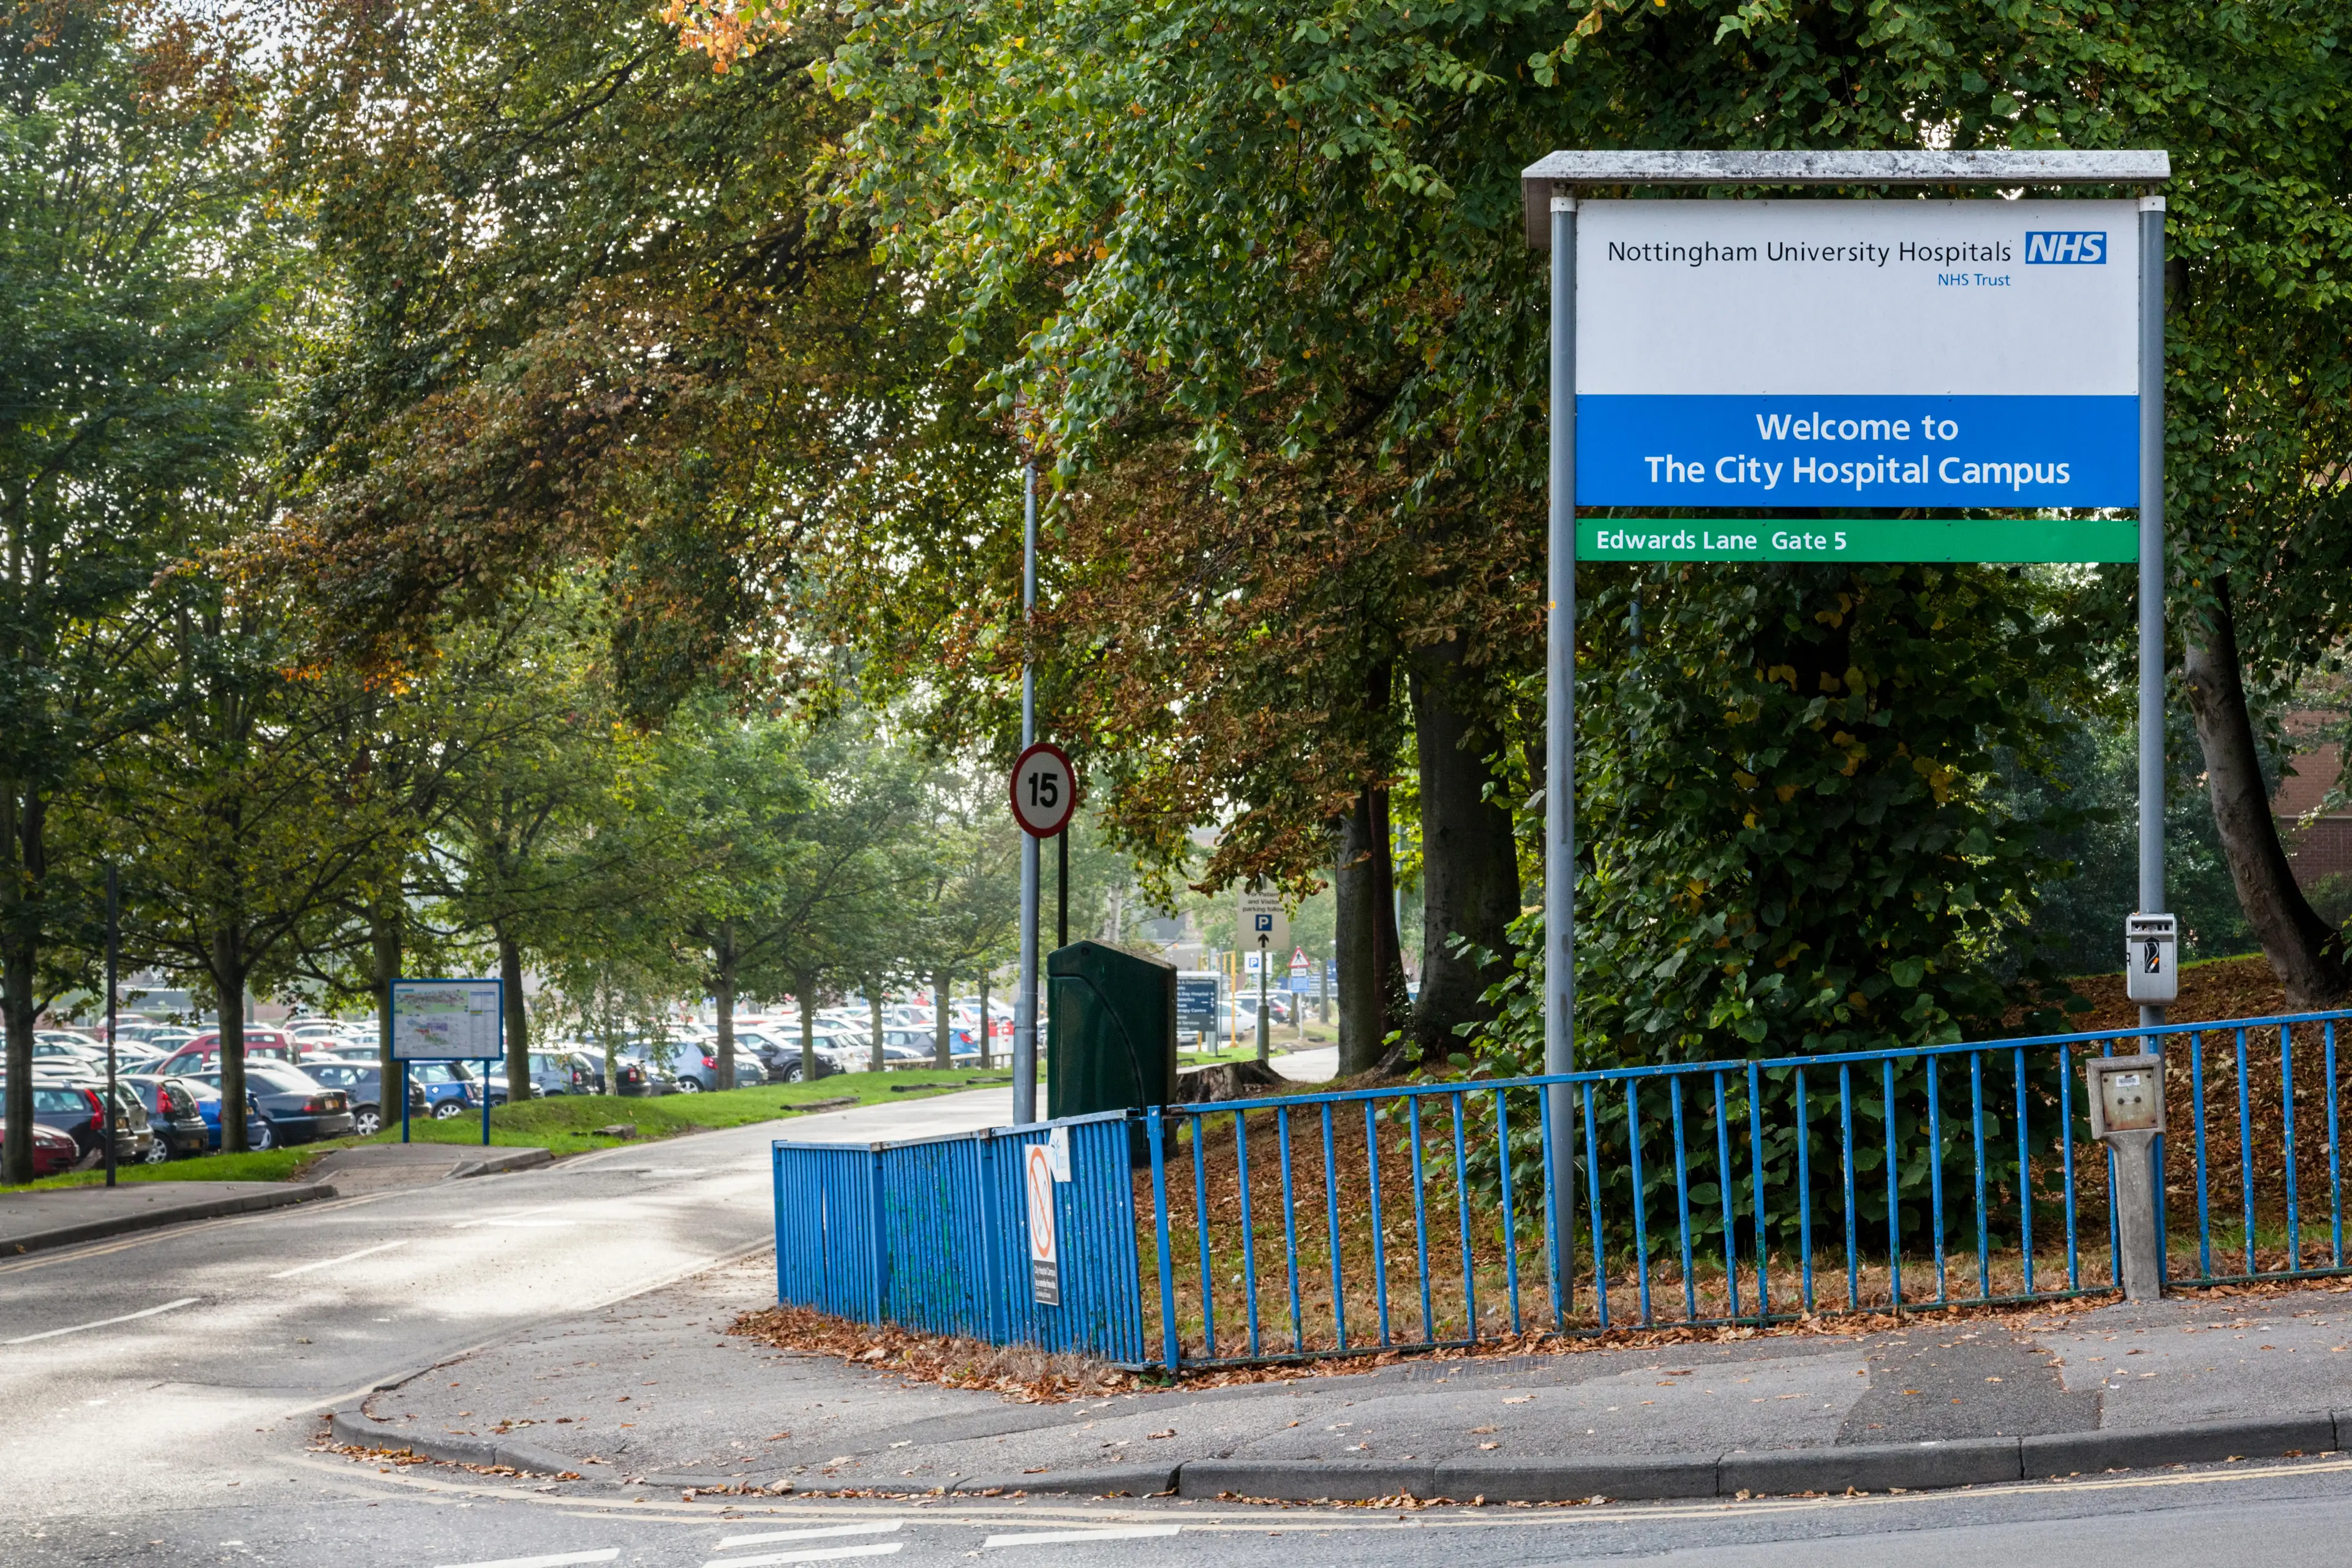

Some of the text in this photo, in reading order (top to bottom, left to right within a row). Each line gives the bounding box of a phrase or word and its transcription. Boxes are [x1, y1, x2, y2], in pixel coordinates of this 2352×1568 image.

[1609, 241, 2011, 268] Nottingham University Hospitals
[2027, 234, 2104, 262] NHS
[1938, 273, 2010, 286] NHS Trust
[1755, 411, 1959, 440] Welcome to
[1644, 454, 2070, 492] The City Hospital Campus
[1597, 529, 1847, 550] Edwards Lane Gate 5
[1028, 772, 1058, 808] 15
[1258, 916, 1269, 929] P
